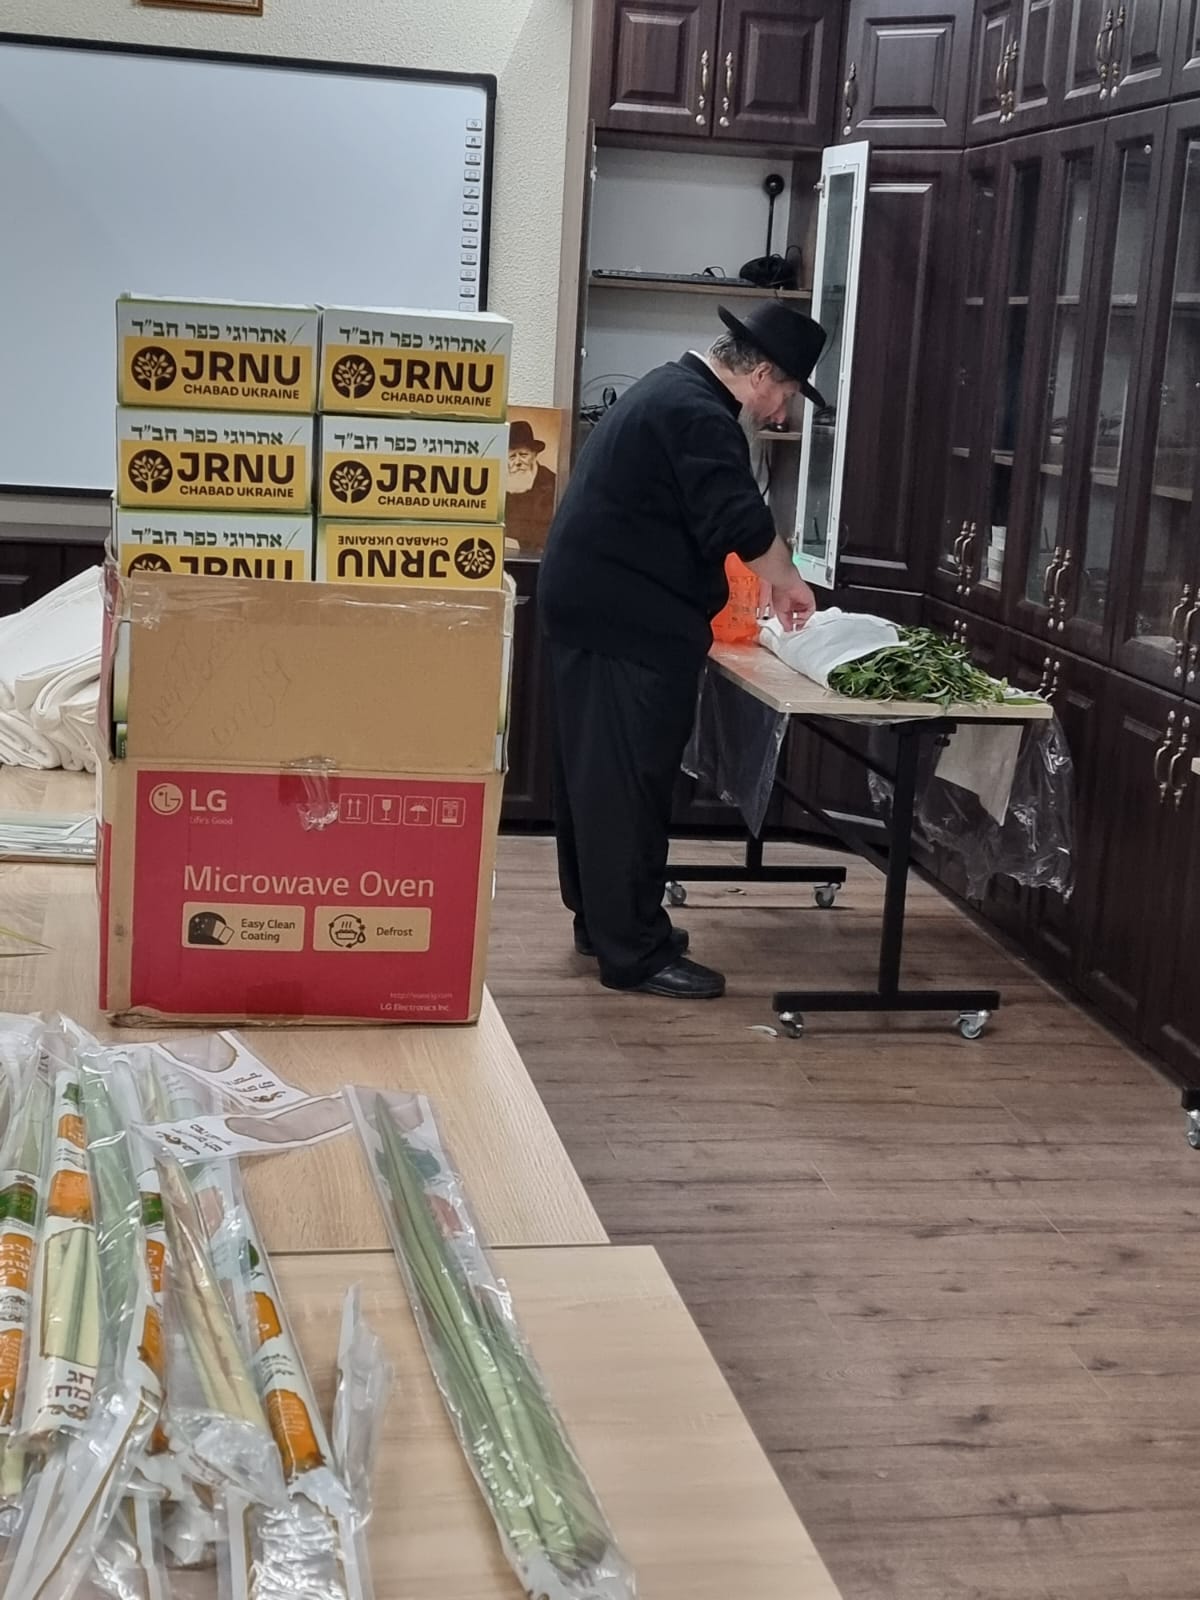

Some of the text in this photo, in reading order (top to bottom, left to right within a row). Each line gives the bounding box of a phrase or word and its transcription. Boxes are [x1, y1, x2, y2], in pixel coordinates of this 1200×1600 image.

[184, 322, 220, 340] כפר
[390, 330, 423, 349] כפר
[181, 349, 301, 386] JRNU
[379, 358, 494, 394] JRNU
[183, 384, 300, 400] CHABAD UKRAINE
[380, 391, 492, 407] CHABAD UKRAINE
[384, 435, 417, 452] כפר
[176, 451, 295, 485] JRNU
[375, 463, 489, 496] JRNU
[179, 485, 294, 498] CHABAD UKRAINE
[377, 495, 487, 509] CHABAD UKRAINE
[183, 530, 218, 546] כפר
[338, 535, 449, 547] CHABAD UKRAINE
[336, 548, 451, 578] JRNU
[190, 788, 227, 812] LG
[183, 865, 435, 898] Microwave Oven
[240, 918, 296, 930] Easy Clean
[376, 926, 414, 937] Defrost
[240, 931, 280, 943] Coating
